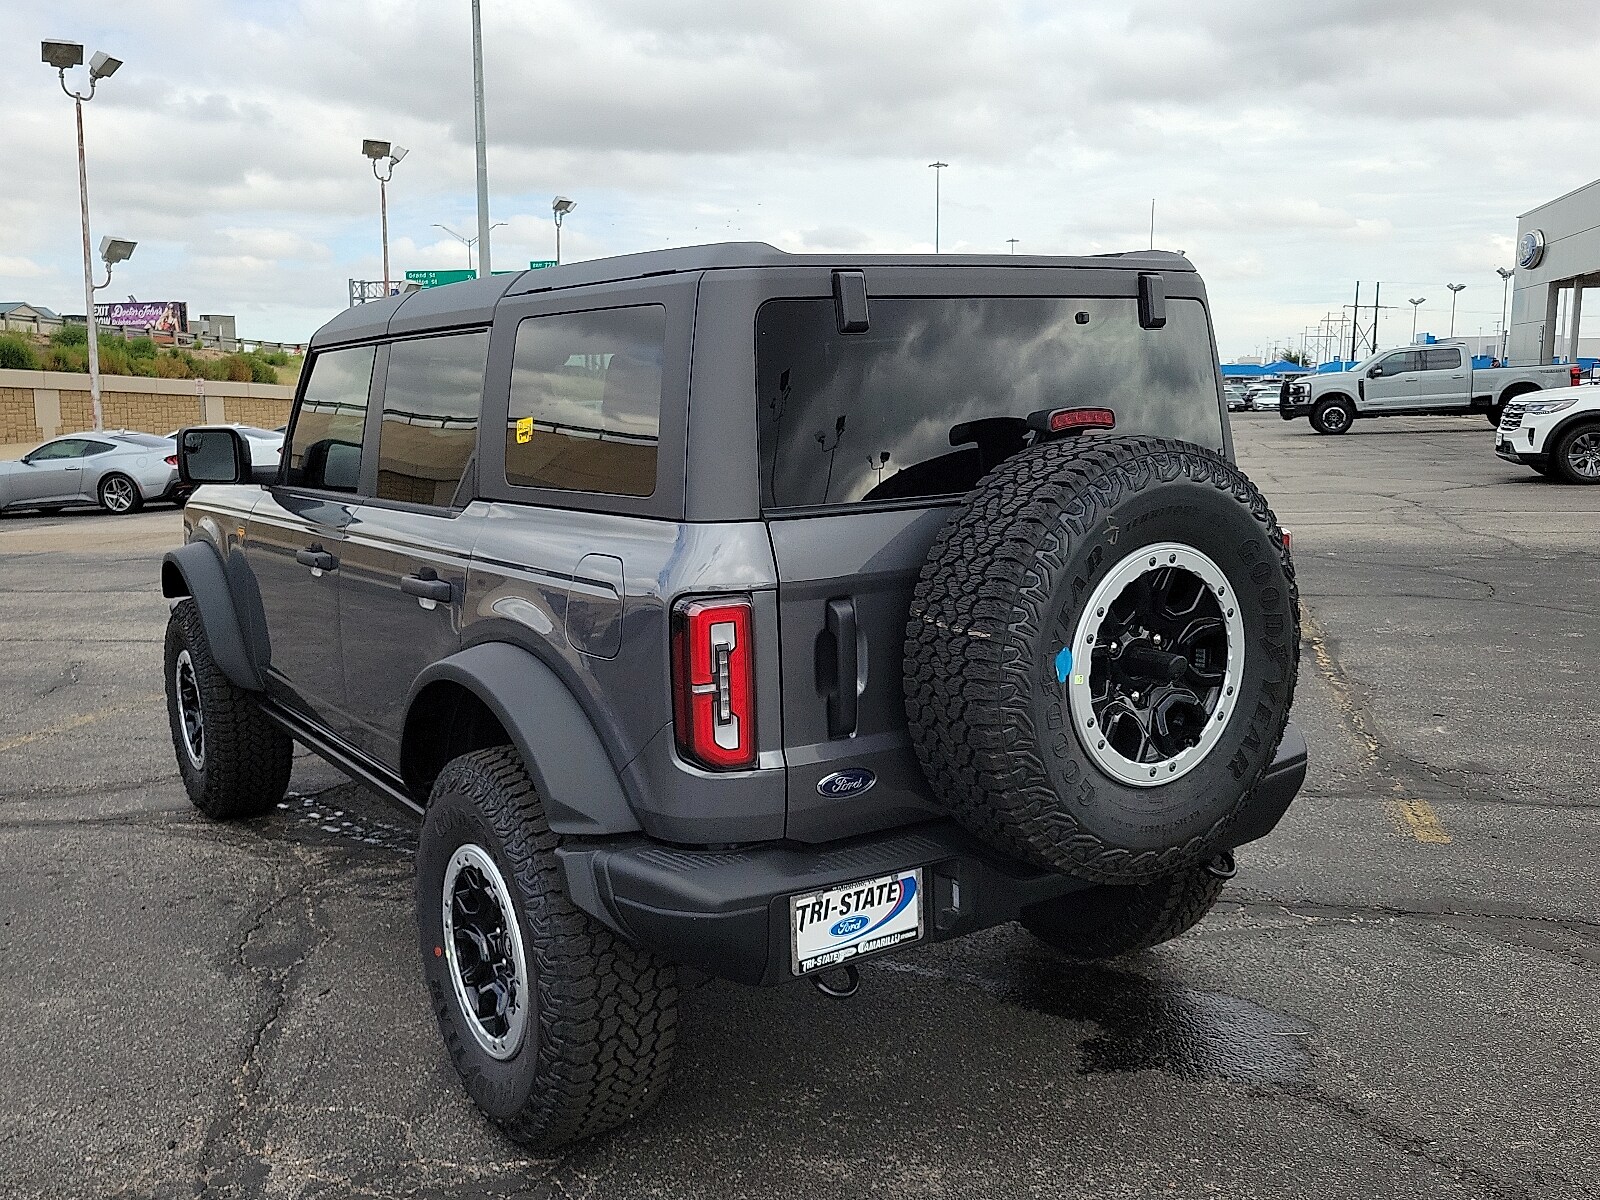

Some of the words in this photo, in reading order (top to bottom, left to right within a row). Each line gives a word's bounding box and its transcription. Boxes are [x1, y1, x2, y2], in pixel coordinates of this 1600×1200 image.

[93, 305, 110, 317] EXIT
[111, 304, 139, 318] Doctor
[1228, 538, 1289, 780] GOODYEAR
[796, 881, 900, 934] TRI-STATE
[837, 917, 862, 935] Ford
